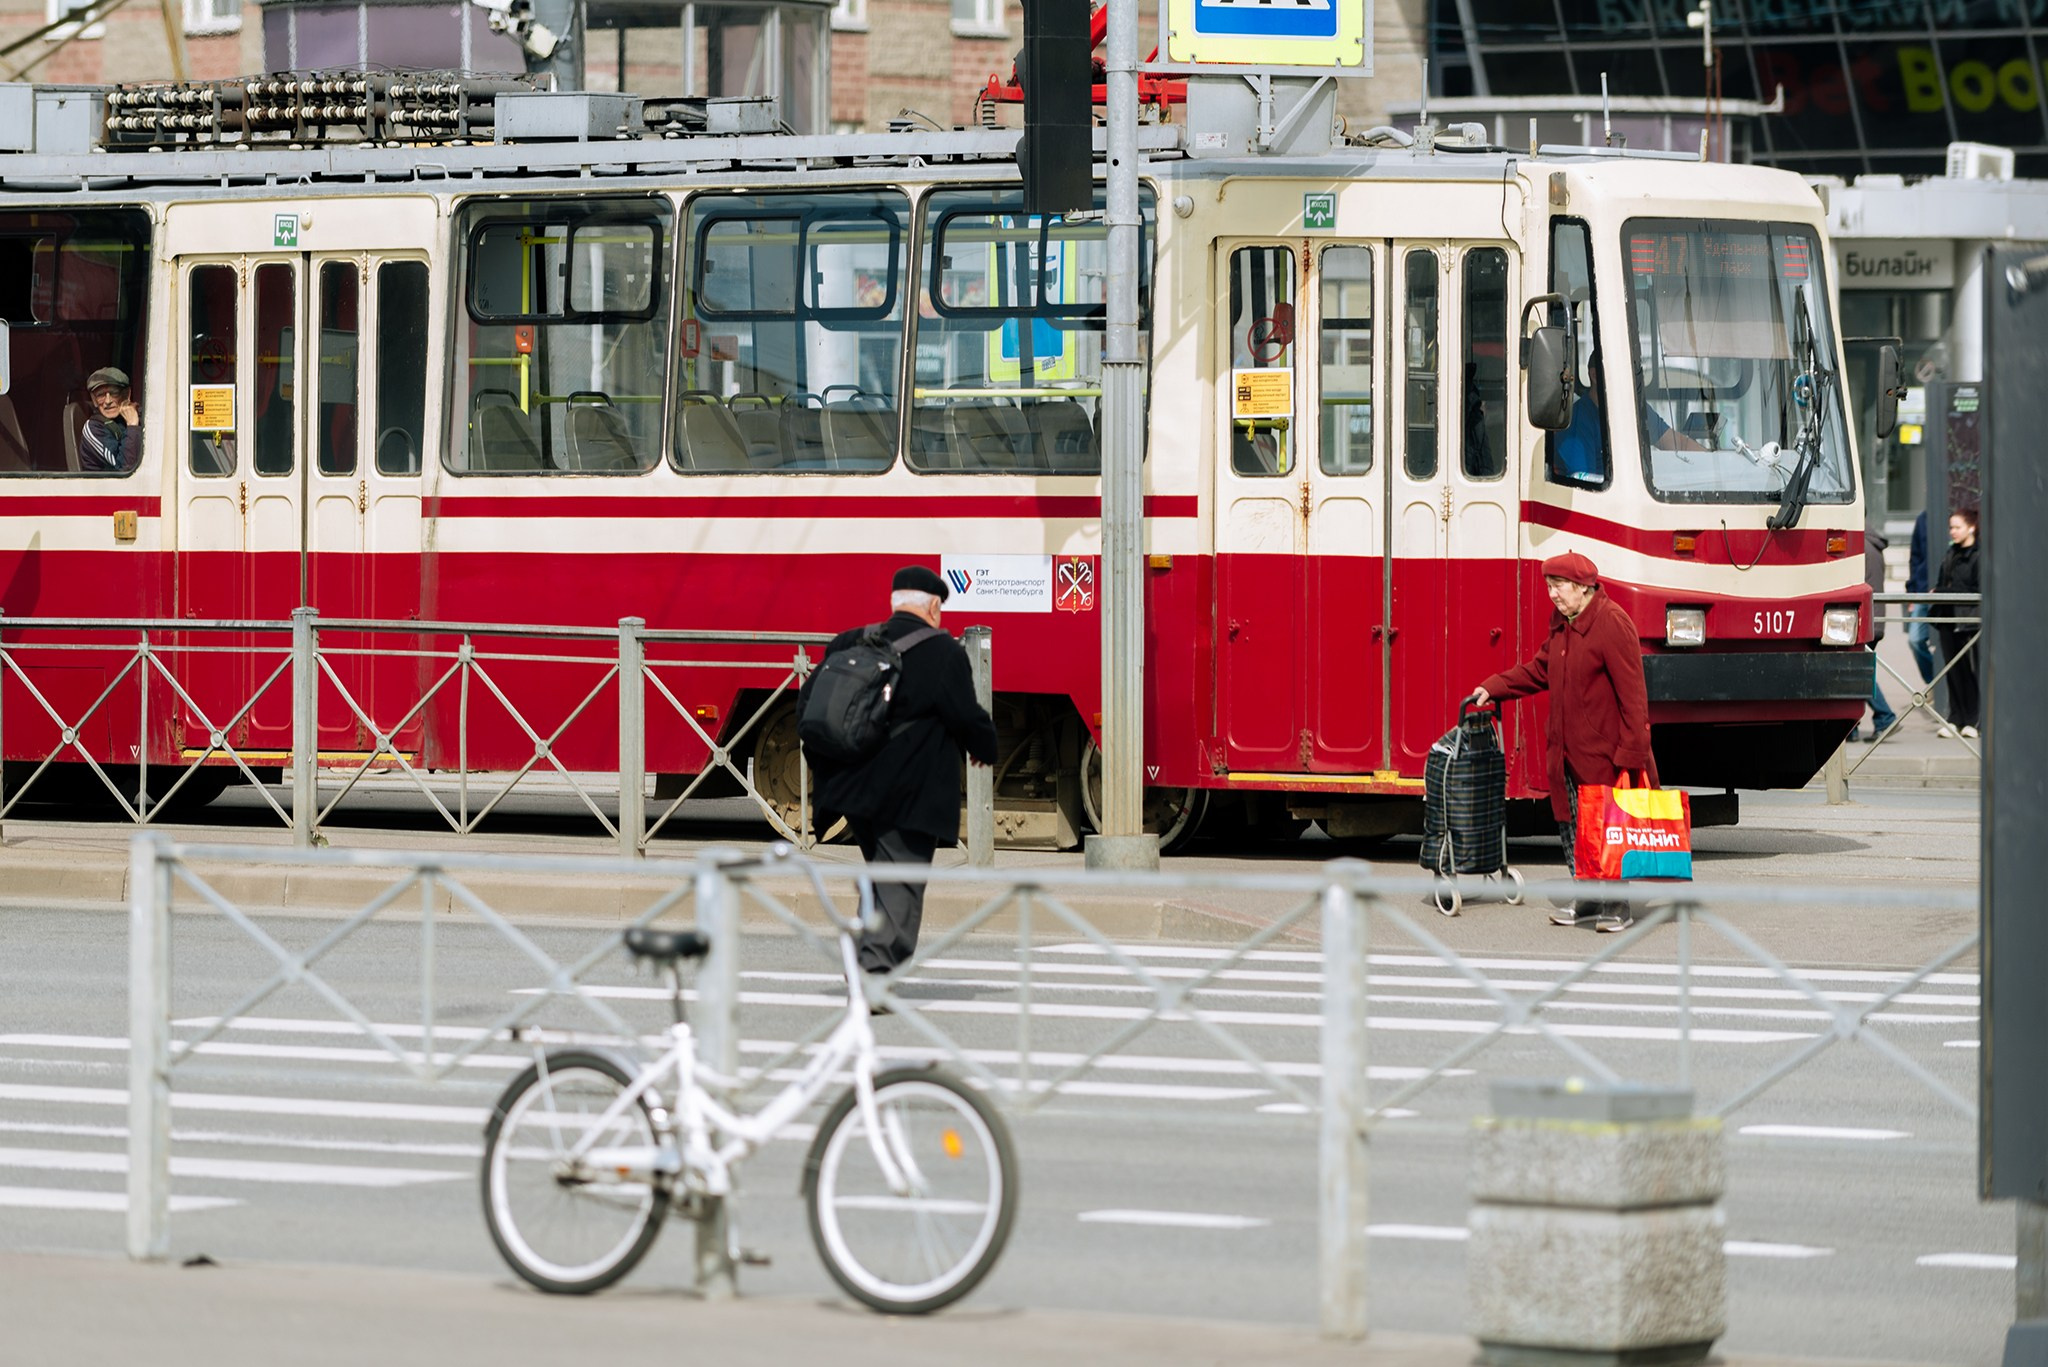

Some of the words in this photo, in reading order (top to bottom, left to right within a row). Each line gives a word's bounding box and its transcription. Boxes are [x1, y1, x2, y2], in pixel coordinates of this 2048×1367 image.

[1898, 47, 2048, 112] Boo
[1654, 235, 1688, 275] 47
[1845, 250, 1933, 277] билайн
[975, 568, 990, 577] ГЭТ
[976, 577, 1045, 588] Электротранспорт
[975, 586, 1044, 597] Санкт-Петербурга
[1753, 610, 1795, 634] 5107
